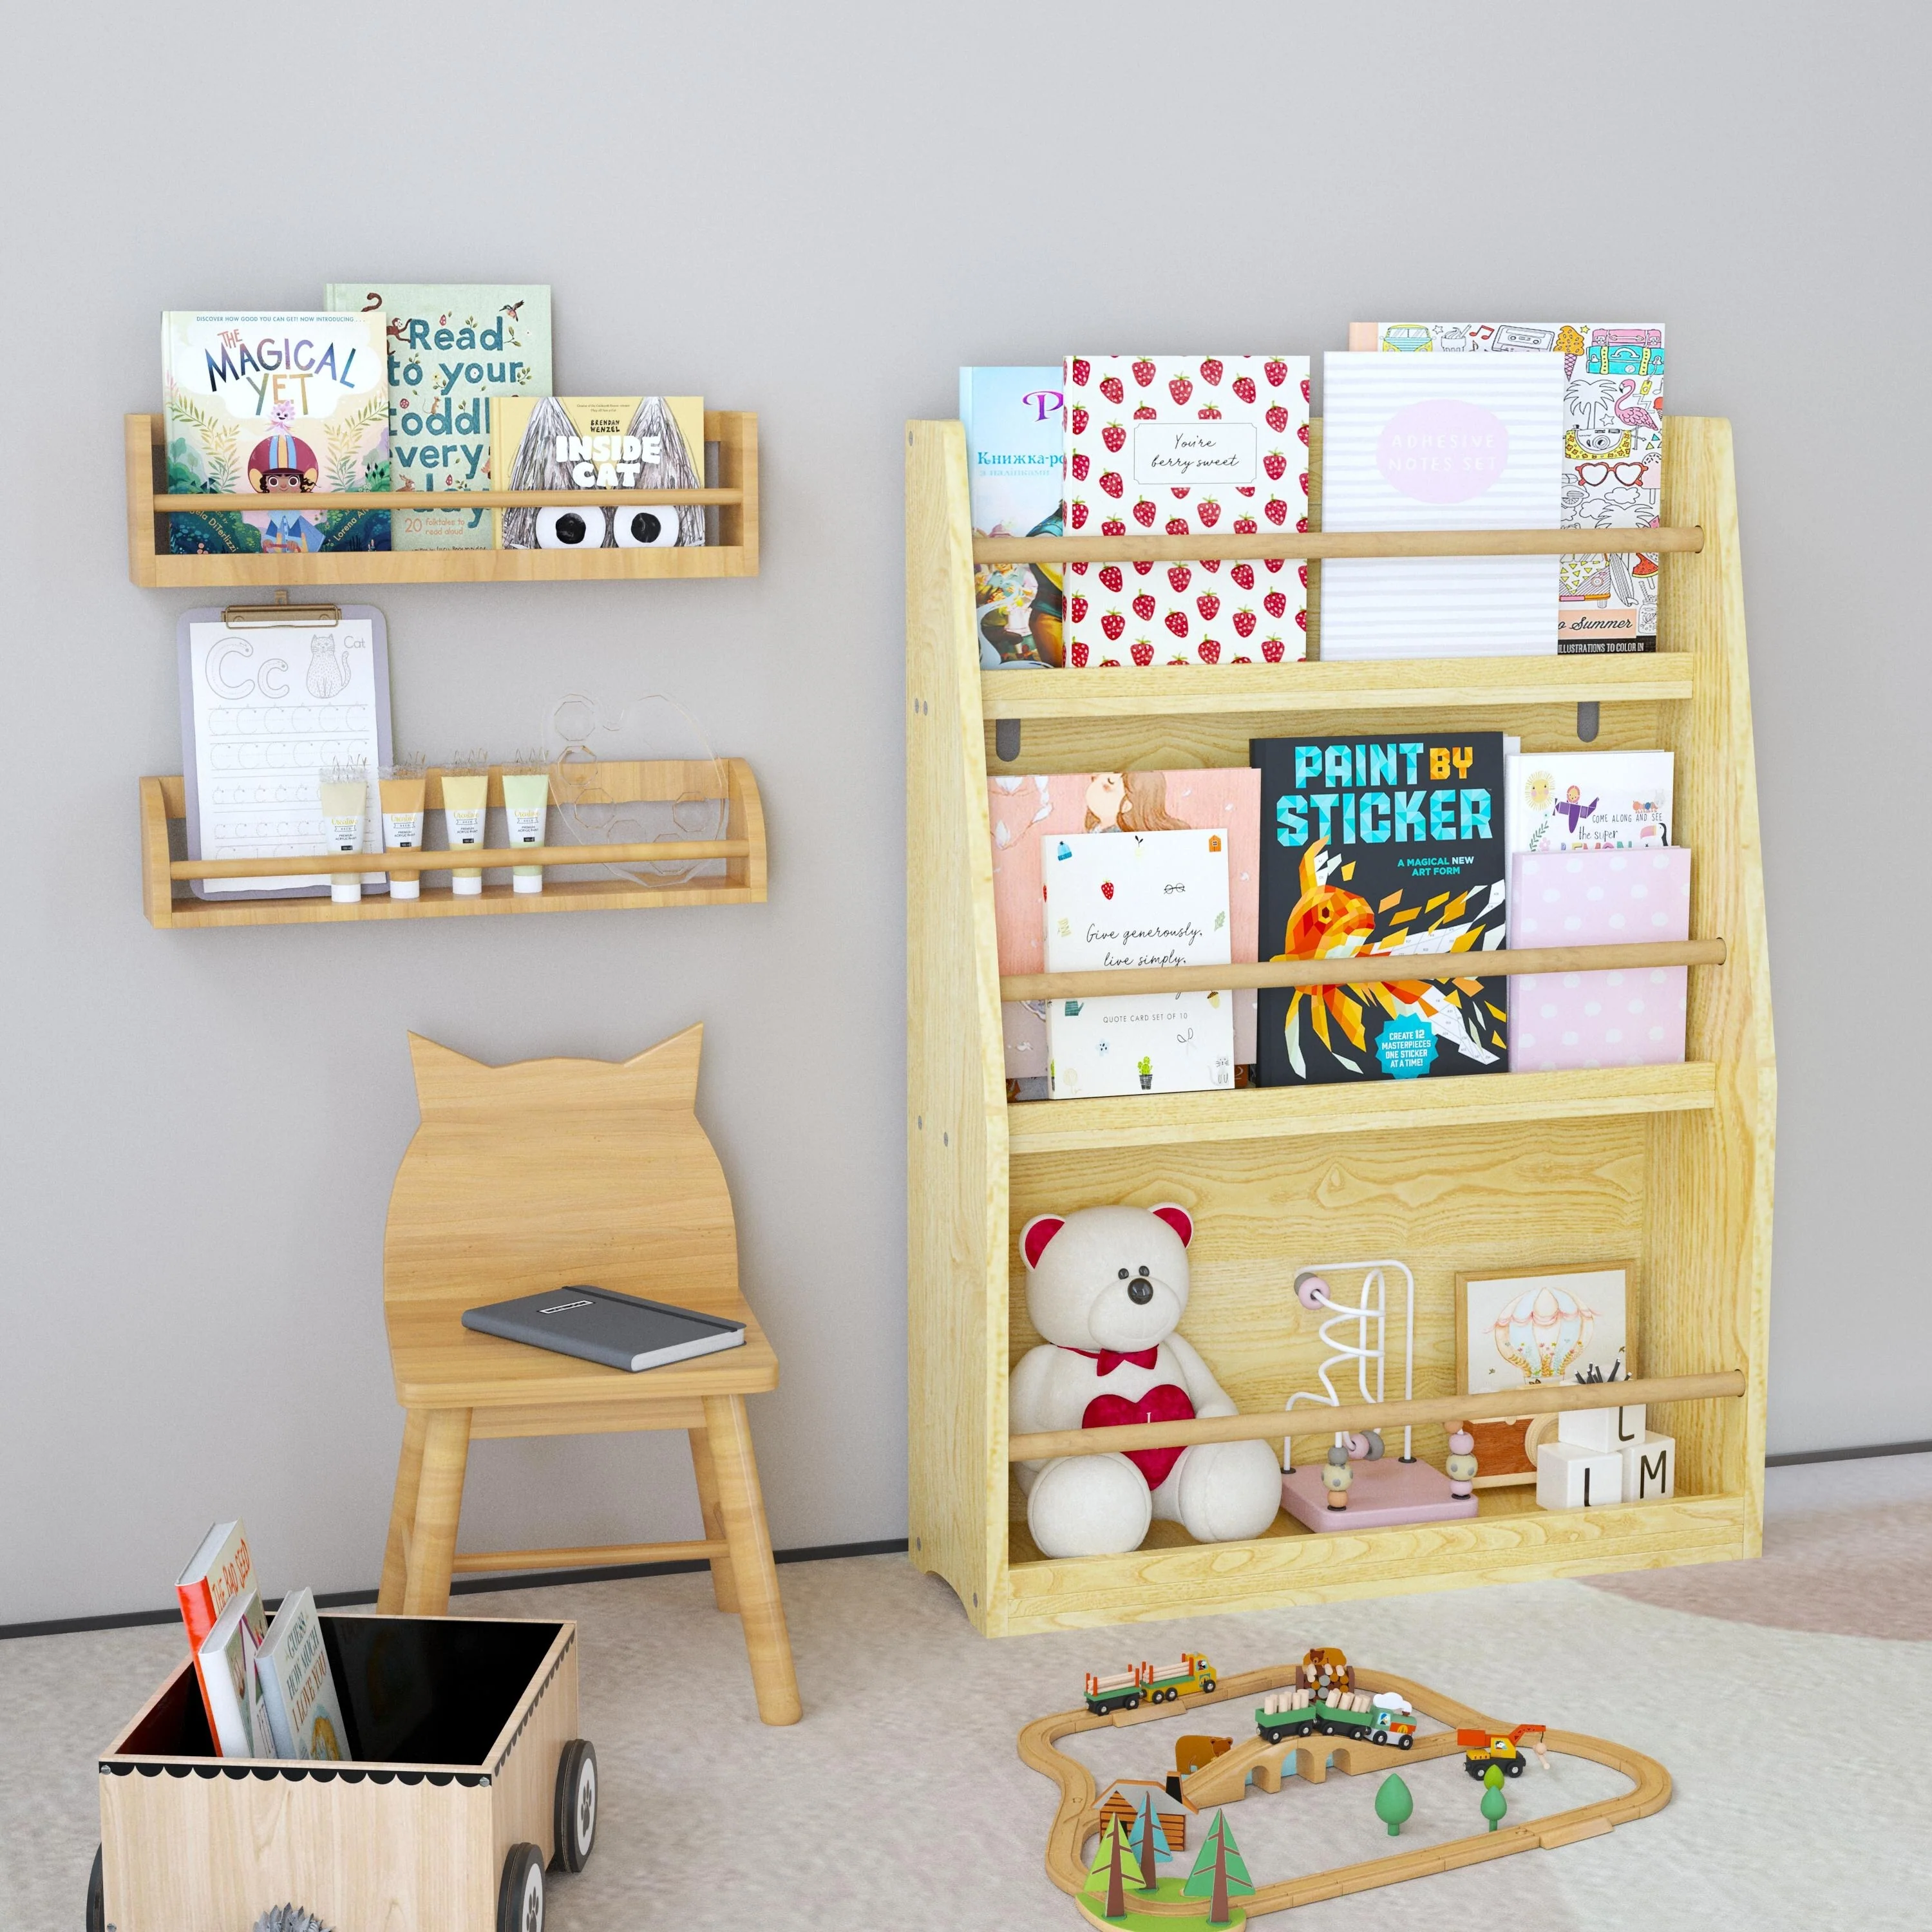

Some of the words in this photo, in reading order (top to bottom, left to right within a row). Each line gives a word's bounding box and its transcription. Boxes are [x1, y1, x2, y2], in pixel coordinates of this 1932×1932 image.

[217, 329, 243, 349] THE
[409, 316, 504, 350] Read
[205, 338, 356, 392] MAGICAL
[387, 355, 423, 386] to
[439, 362, 524, 395] your
[246, 373, 314, 415] YET
[556, 434, 661, 464] INSIDE
[1175, 433, 1217, 450] You're
[1392, 434, 1495, 448] ADHESIVE
[389, 444, 484, 480] very
[1151, 454, 1195, 474] berry
[1196, 454, 1240, 467] sweet
[1388, 457, 1452, 471] NOTES
[1463, 457, 1497, 471] SET
[572, 462, 640, 488] CAT
[208, 518, 239, 553] DiTerlizzi
[333, 518, 357, 542] Lorena
[404, 518, 422, 533] 20
[1569, 616, 1633, 630] Summer
[343, 636, 366, 649] Cat
[1607, 643, 1615, 652] TO
[1616, 643, 1636, 652] COLOR
[1637, 643, 1644, 651] IN
[1294, 743, 1425, 789] PAINT
[1430, 746, 1473, 780] BY
[1276, 788, 1493, 847] STICKER
[1592, 814, 1609, 823] COME
[1612, 814, 1632, 822] ALONG
[1636, 813, 1647, 822] AND
[1651, 813, 1663, 821] SEE
[1578, 826, 1591, 840] the
[1594, 829, 1618, 842] super
[1406, 857, 1450, 867] MAGICAL
[1452, 856, 1474, 865] NEW
[1412, 868, 1431, 876] ART
[1433, 867, 1461, 876] FORM
[1086, 923, 1119, 943] Give
[1104, 952, 1133, 966] live
[1381, 1040, 1431, 1050] MASTERPIECES
[1389, 1032, 1414, 1041] CREATE
[1414, 1029, 1425, 1039] 12
[1385, 1050, 1399, 1059] ONE
[1400, 1049, 1428, 1058] STICKER
[1405, 1059, 1423, 1067] TIME!
[1640, 1450, 1667, 1499] M
[287, 1612, 307, 1659] GUESS
[286, 1663, 303, 1701] HOW
[301, 1625, 319, 1671] MUCH
[292, 1708, 299, 1733] I
[296, 1676, 315, 1725] LOVE
[312, 1651, 327, 1691] YOU
